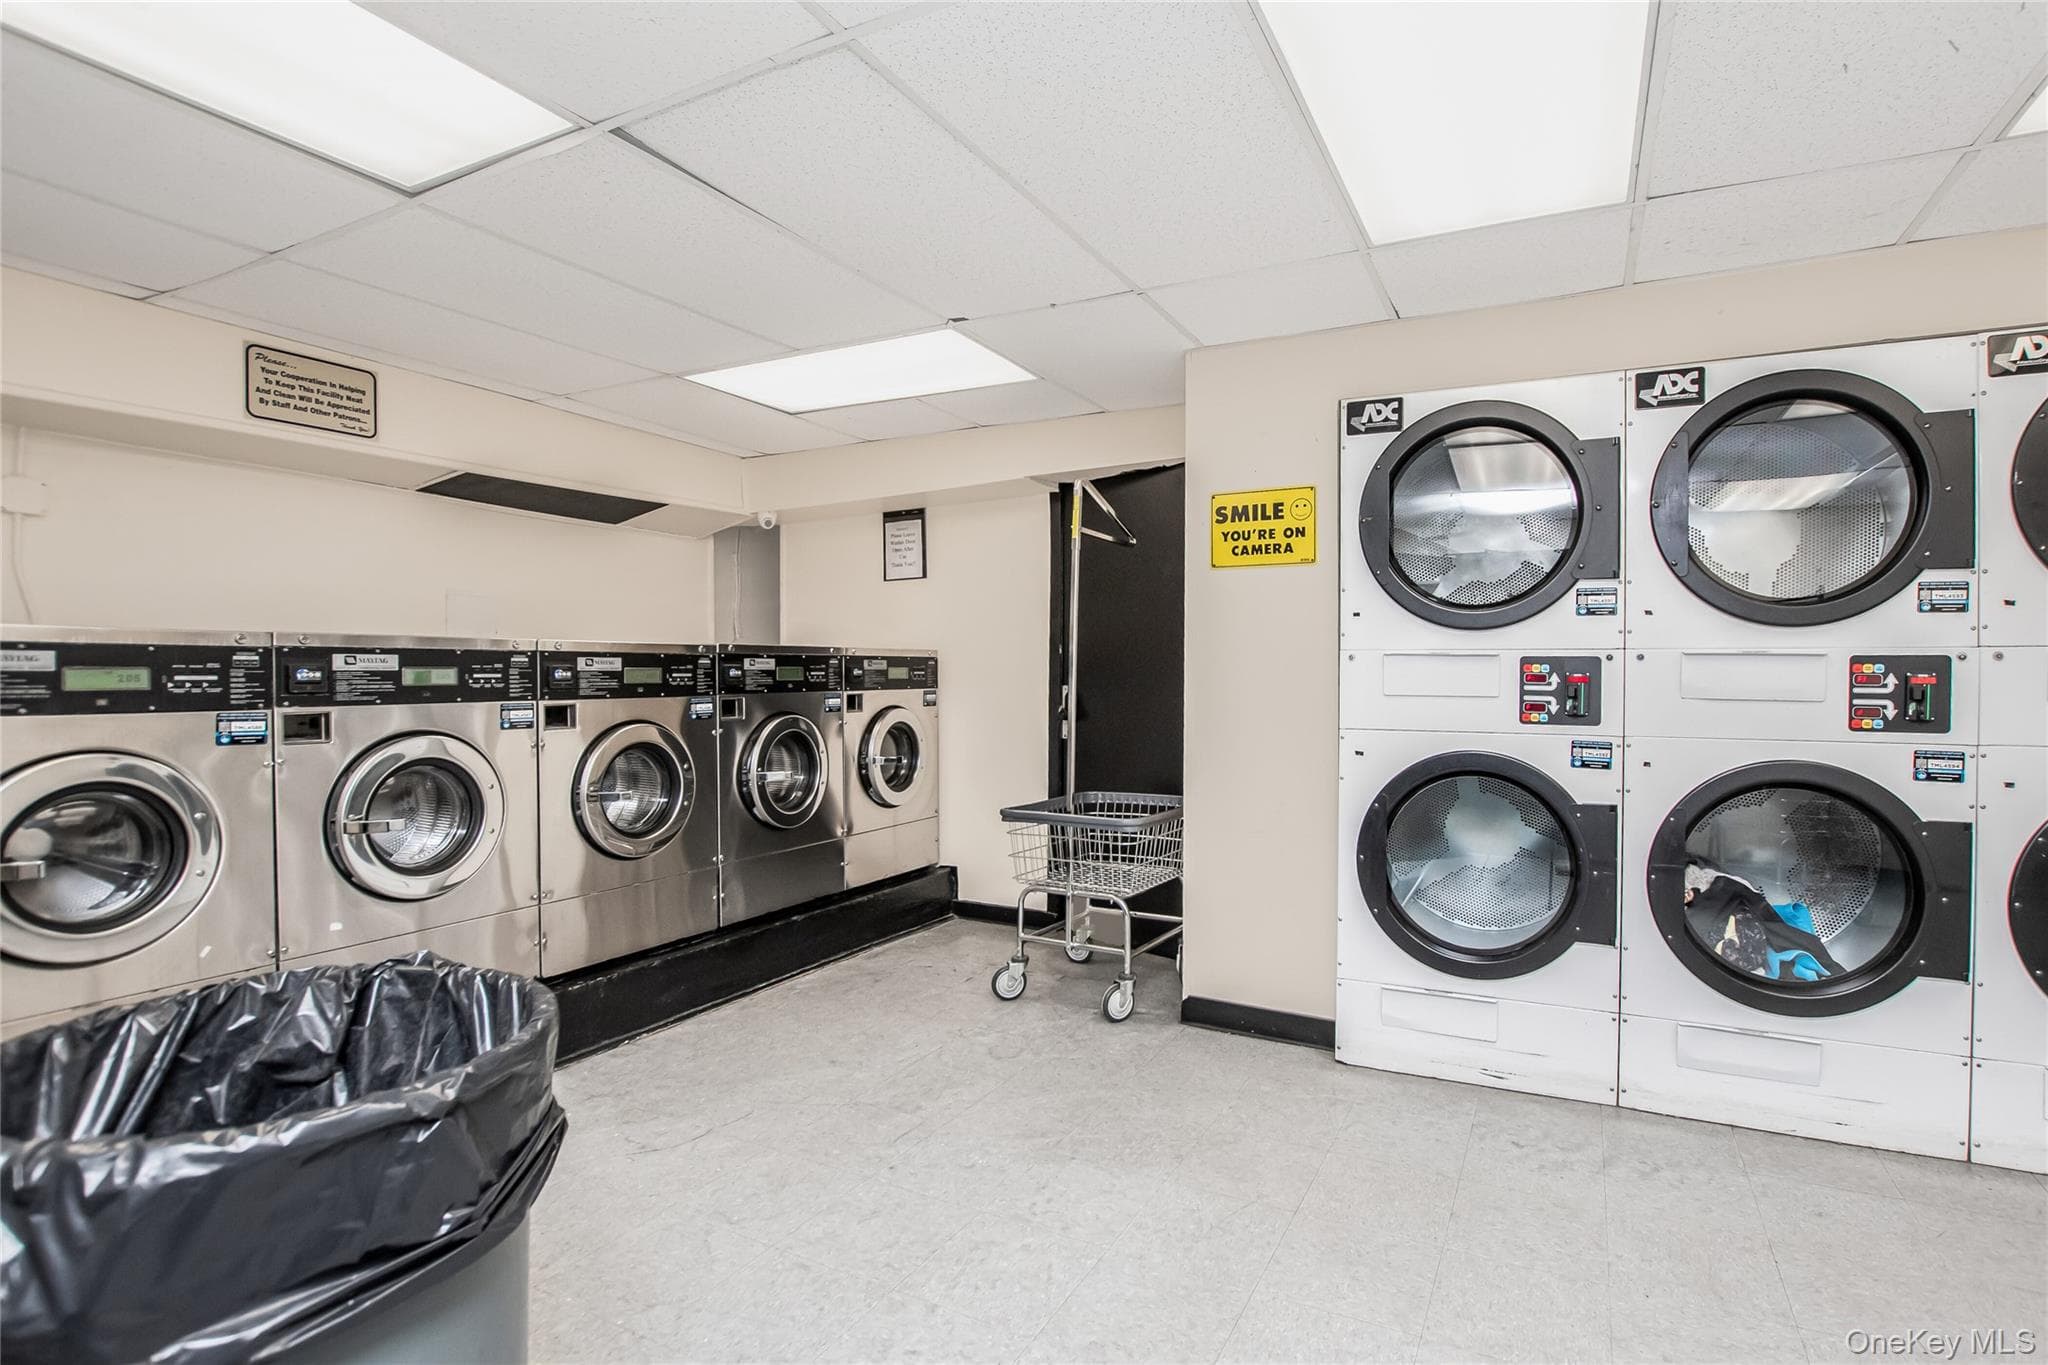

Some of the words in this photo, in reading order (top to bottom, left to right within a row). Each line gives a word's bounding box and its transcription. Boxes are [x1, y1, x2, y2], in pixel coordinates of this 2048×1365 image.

[260, 366, 278, 376] Your
[280, 370, 328, 386] Cooperation
[338, 383, 366, 396] Helping
[264, 377, 274, 385] To
[275, 380, 296, 390] Keep
[298, 384, 314, 394] This
[316, 388, 344, 400] Facility
[346, 395, 363, 404] Neat
[1652, 370, 1698, 395] ADC
[255, 386, 272, 395] And
[273, 390, 296, 400] Clean
[298, 395, 312, 403] Will
[327, 401, 370, 415] Appreciated
[259, 397, 270, 406] By
[272, 400, 291, 408] Staff
[293, 404, 308, 412] And
[310, 407, 331, 416] Other
[1360, 401, 1398, 423] ADC
[1215, 502, 1284, 524] SMILE
[1221, 528, 1276, 542] YOU'RE
[1283, 526, 1306, 538] ON
[1232, 542, 1294, 556] CAMERA
